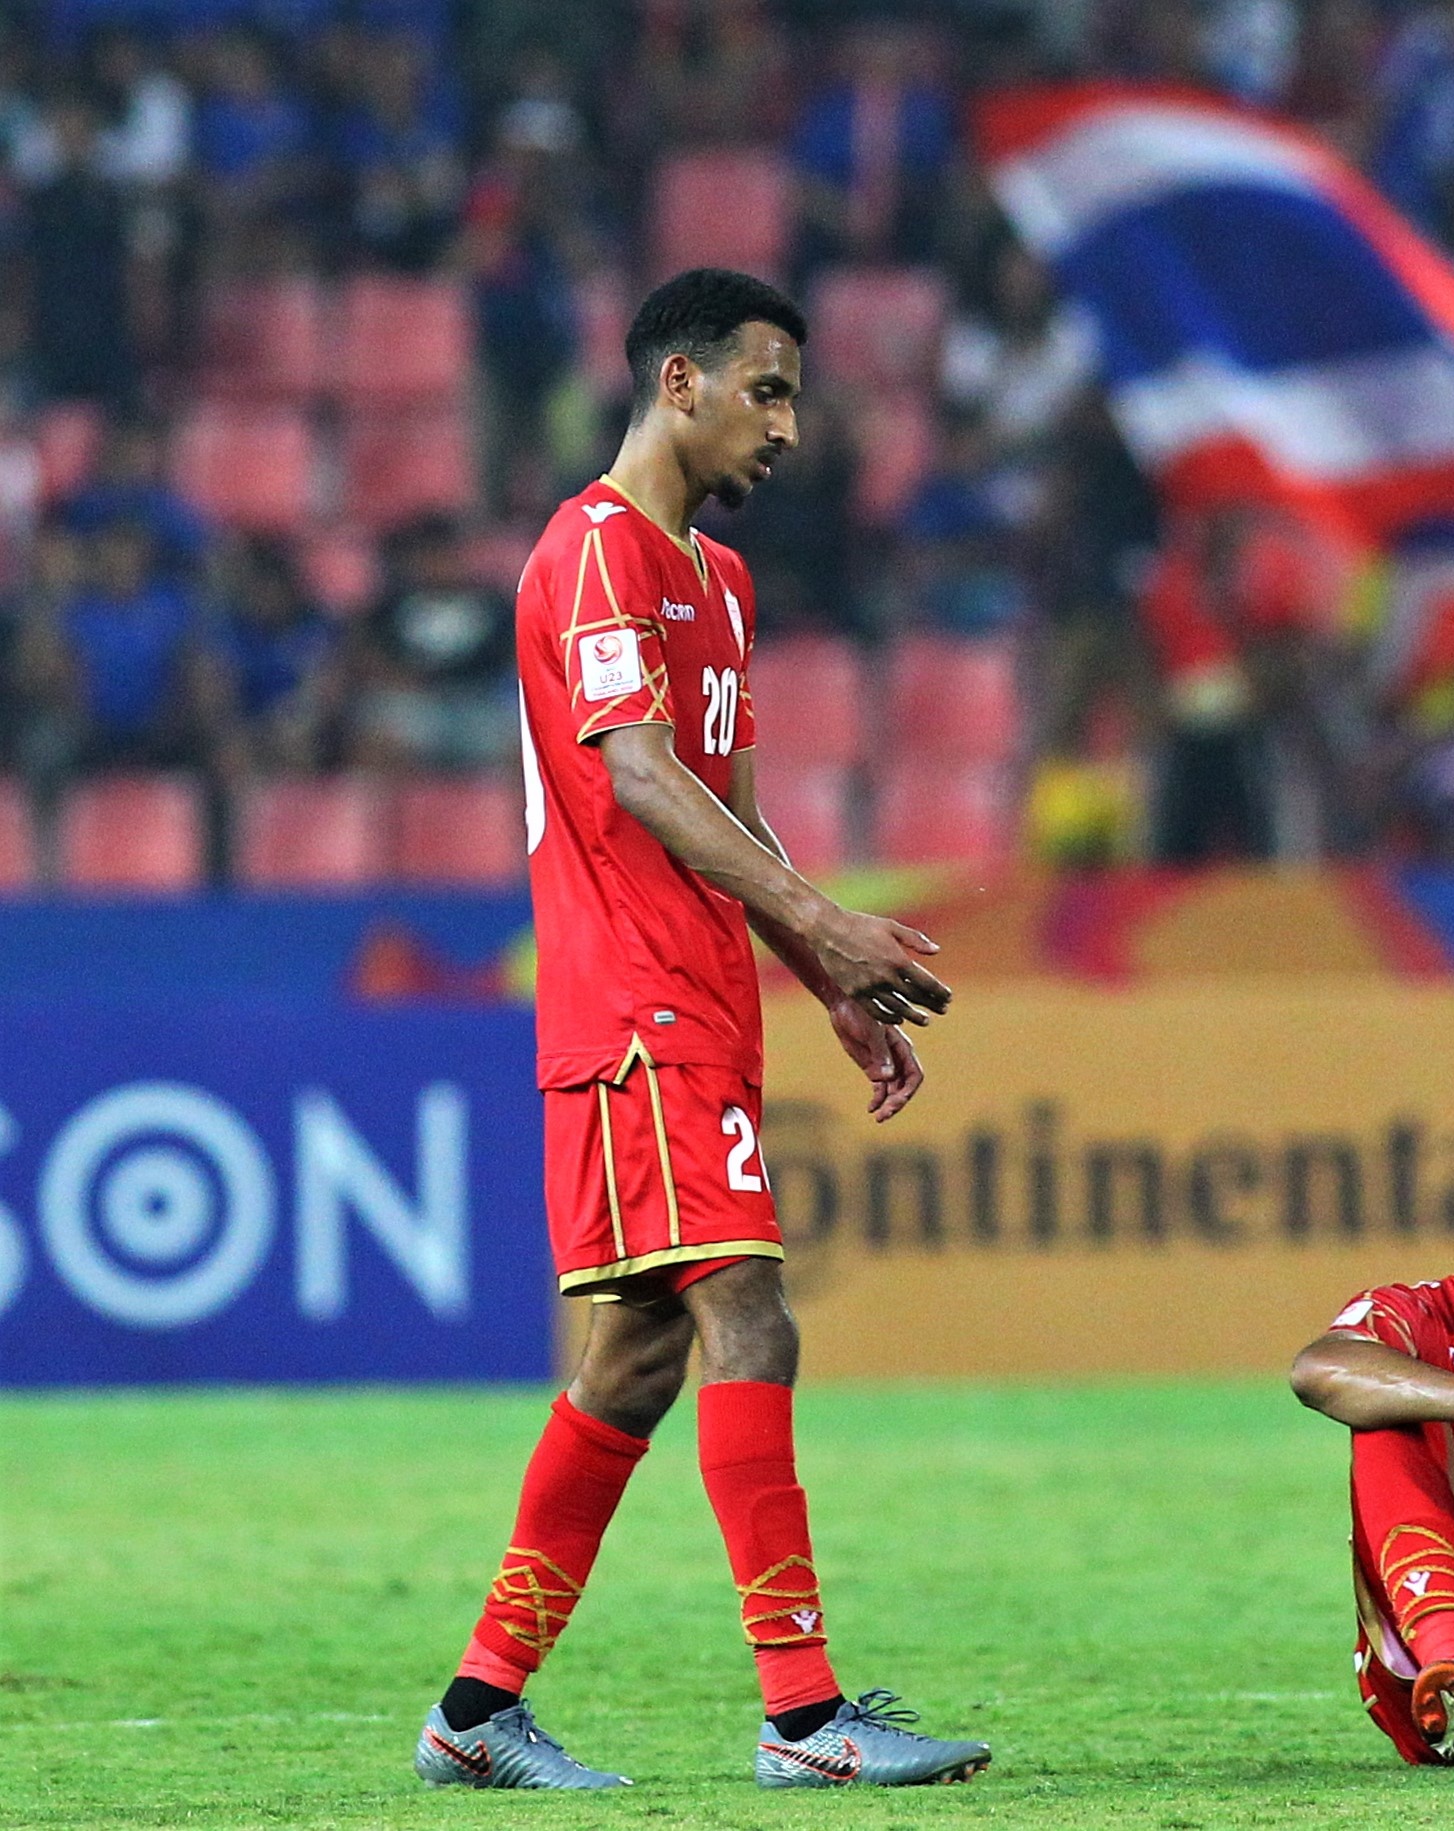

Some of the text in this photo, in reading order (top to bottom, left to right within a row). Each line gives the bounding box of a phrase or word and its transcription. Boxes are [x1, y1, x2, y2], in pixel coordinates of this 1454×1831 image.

[600, 672, 622, 684] U23
[702, 665, 738, 757] 20
[721, 1105, 771, 1193] 2
[0, 1080, 470, 1326] ON
